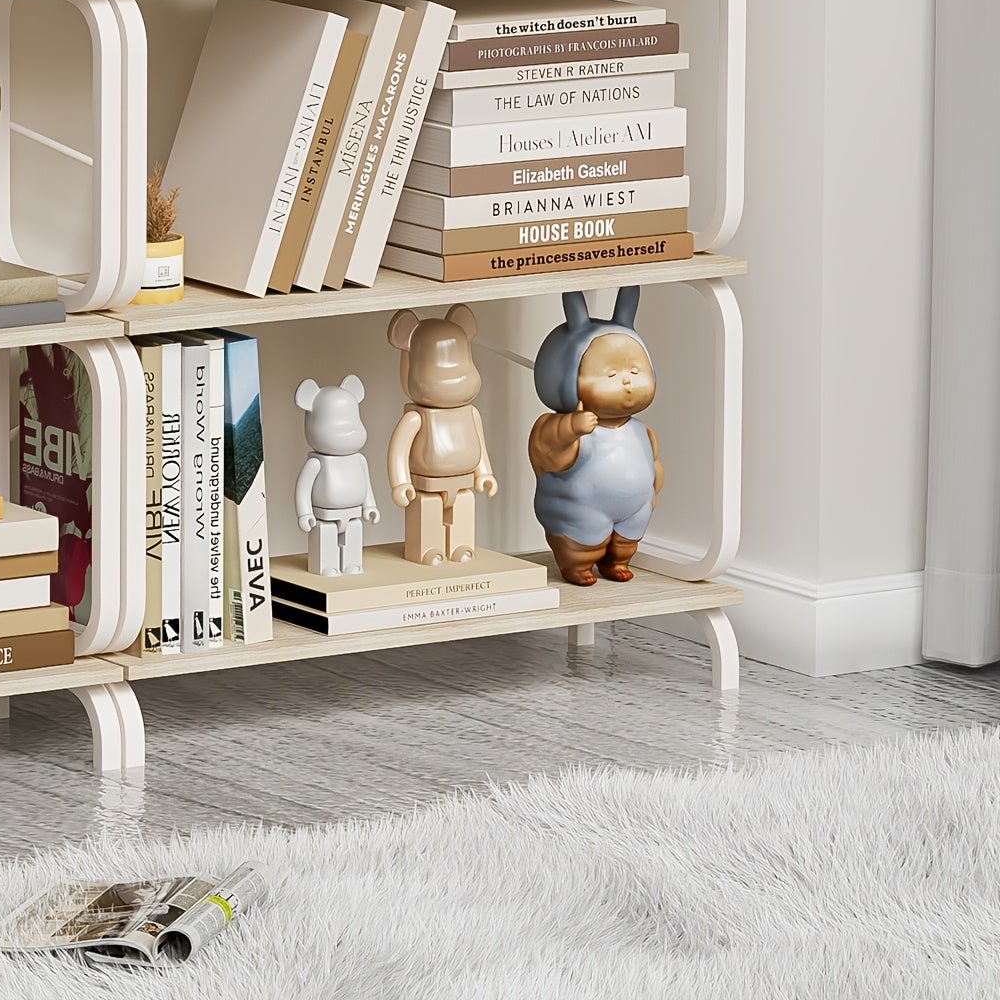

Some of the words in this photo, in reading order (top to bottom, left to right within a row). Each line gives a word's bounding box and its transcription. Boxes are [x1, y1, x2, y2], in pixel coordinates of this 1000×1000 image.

[496, 24, 519, 36] the
[519, 20, 556, 34] witch
[557, 16, 606, 31] doesn't
[607, 14, 638, 26] burn
[478, 44, 552, 60] PHOTOGRAPHS
[554, 43, 566, 54] BY
[568, 39, 617, 52] FRANÇOIS
[618, 36, 658, 48] HALARD
[494, 96, 521, 111] THE
[526, 93, 555, 109] LAW
[559, 91, 576, 106] OF
[582, 85, 641, 103] NATIONS
[344, 144, 379, 234] MERINGUES
[374, 51, 408, 140] MACARONS
[380, 172, 399, 197] THE
[390, 134, 411, 171] THIN
[401, 76, 428, 133] JUSTICE
[500, 134, 554, 154] Houses
[566, 126, 619, 148] Atelier
[622, 122, 652, 142] AM
[300, 117, 334, 202] INSTANBUL
[513, 164, 574, 186] Elizabeth
[577, 159, 628, 179] Gaskell
[519, 223, 569, 244] HOUSE
[574, 218, 616, 240] BOOK
[406, 586, 442, 598] PERFECT
[445, 580, 492, 594] IMPERFECT
[402, 612, 427, 622] EMMA
[430, 602, 497, 618] BAXTER-WRIGHT
